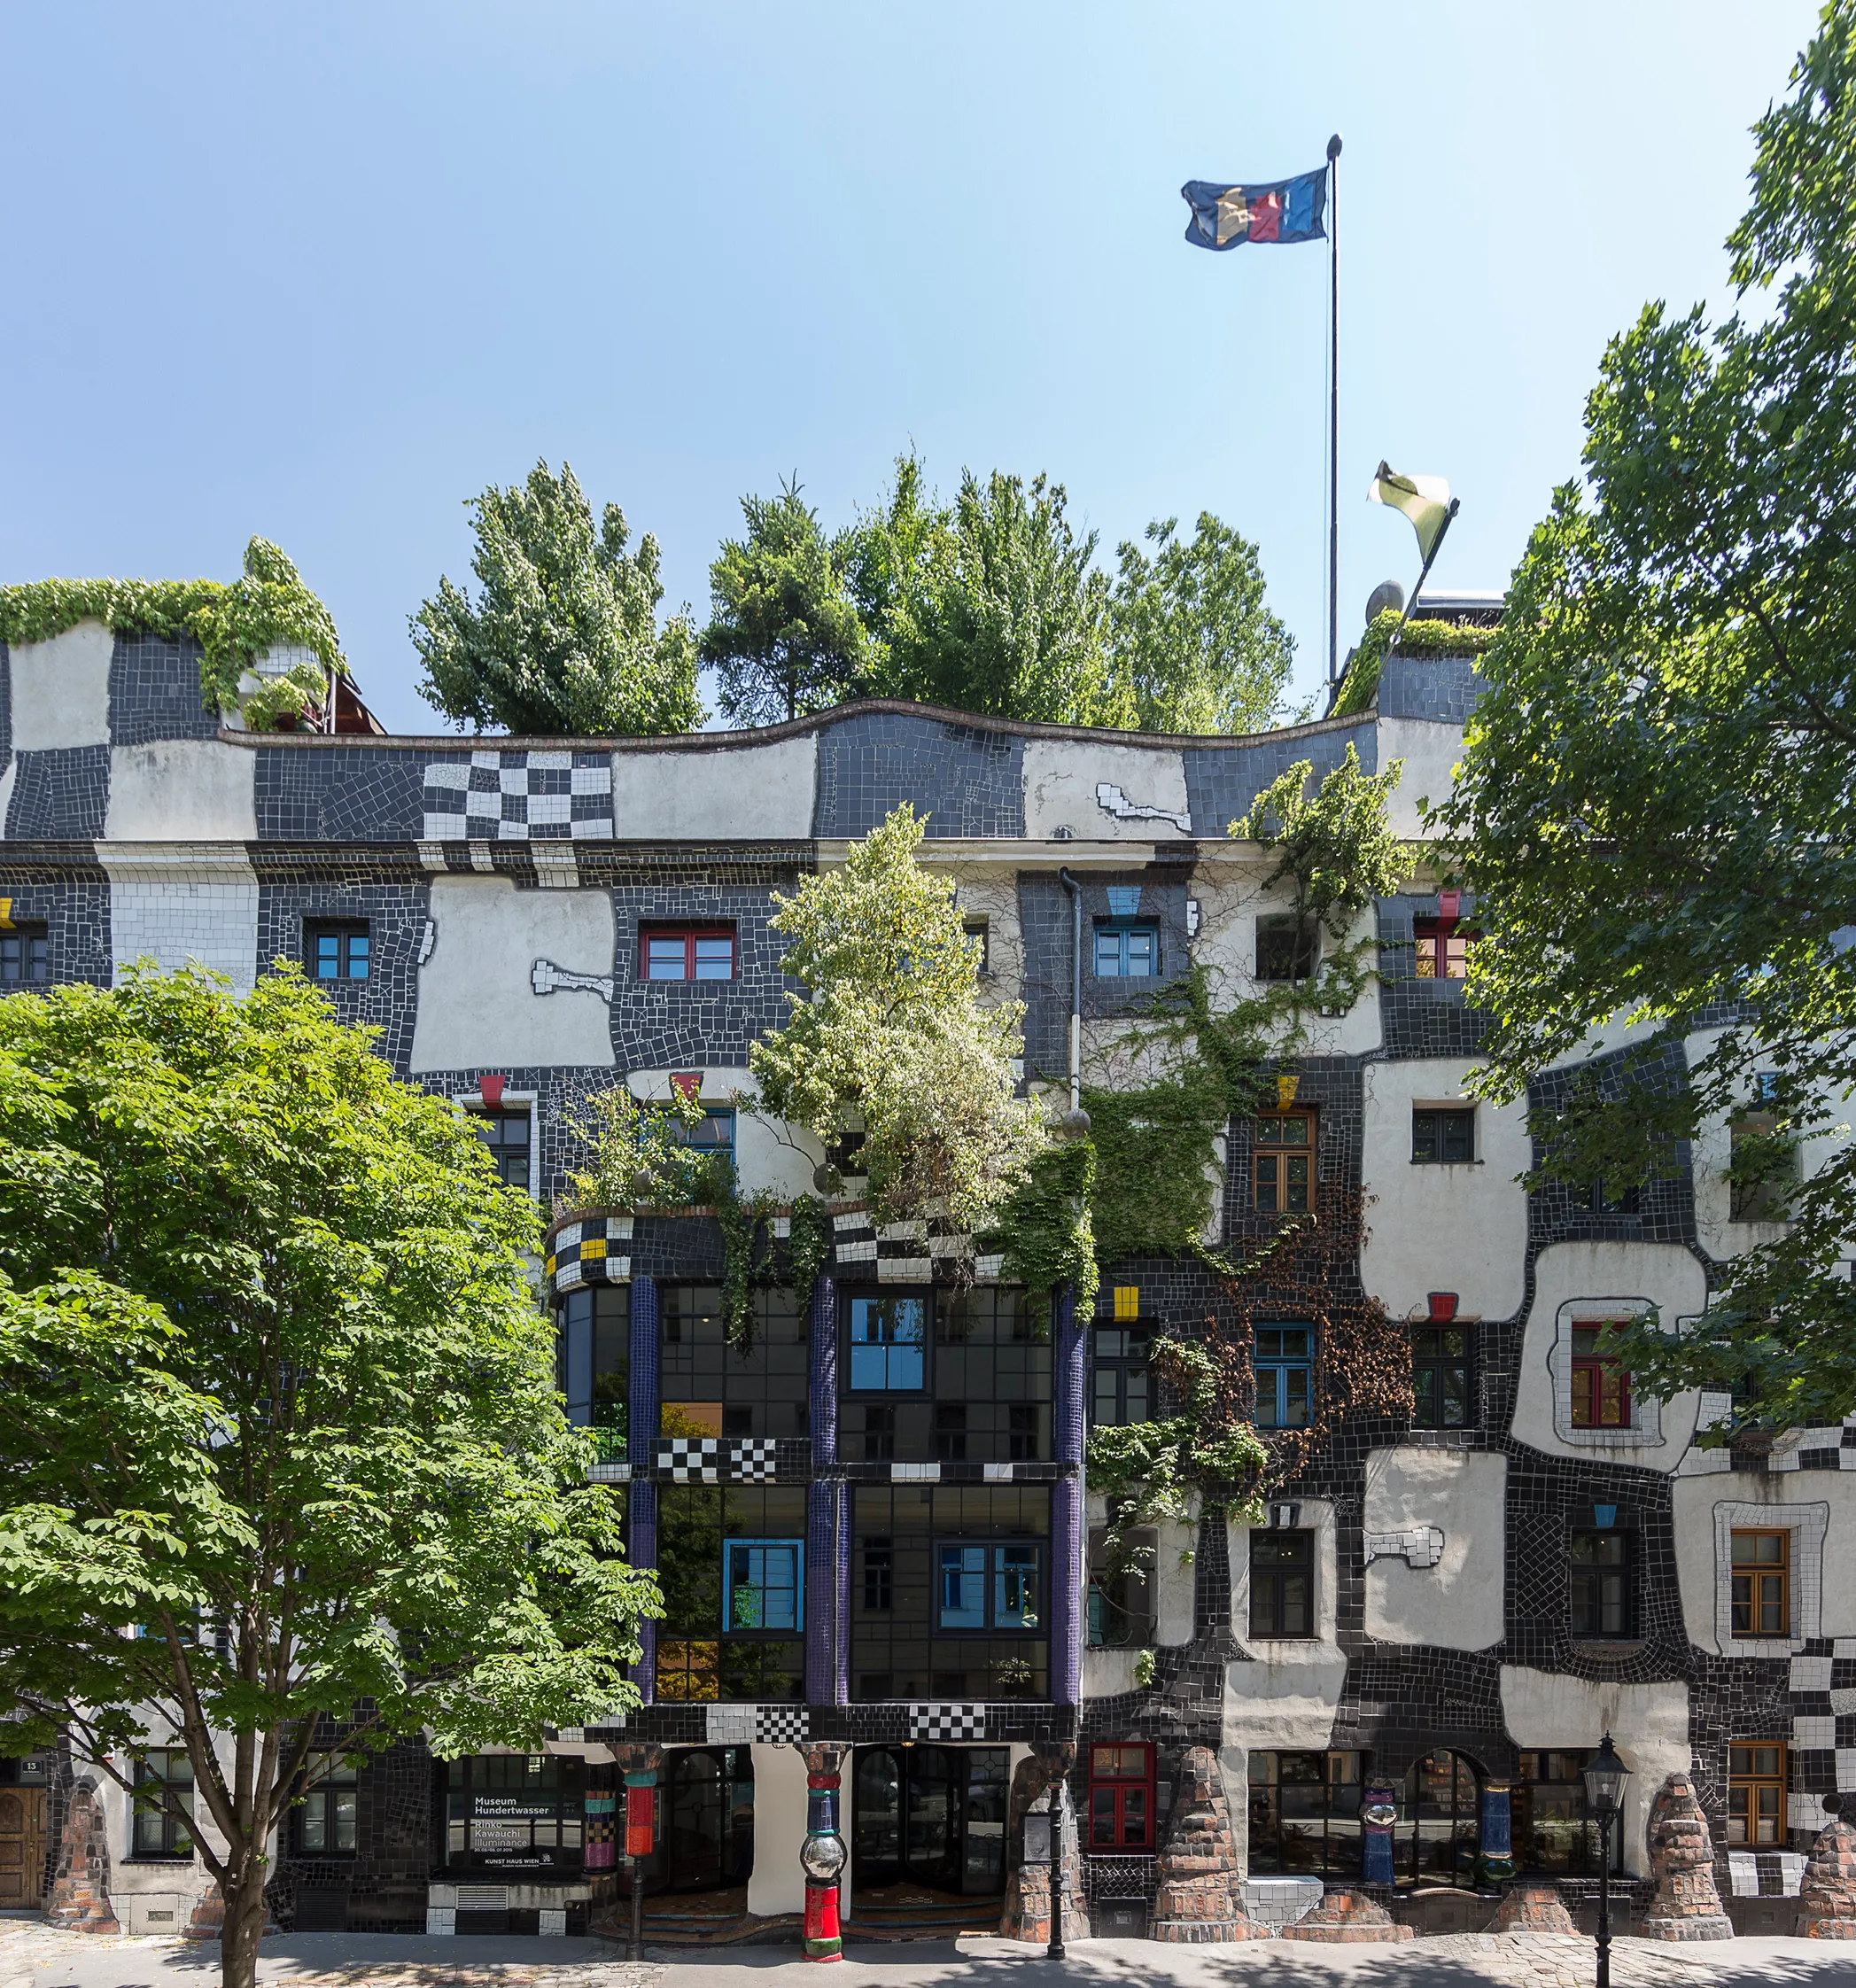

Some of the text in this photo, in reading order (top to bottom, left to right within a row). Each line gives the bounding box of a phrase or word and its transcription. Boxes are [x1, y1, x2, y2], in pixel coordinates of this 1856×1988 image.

[475, 1797, 516, 1806] Museum
[475, 1820, 502, 1829] Rinko
[475, 1829, 521, 1837] Kawauchi
